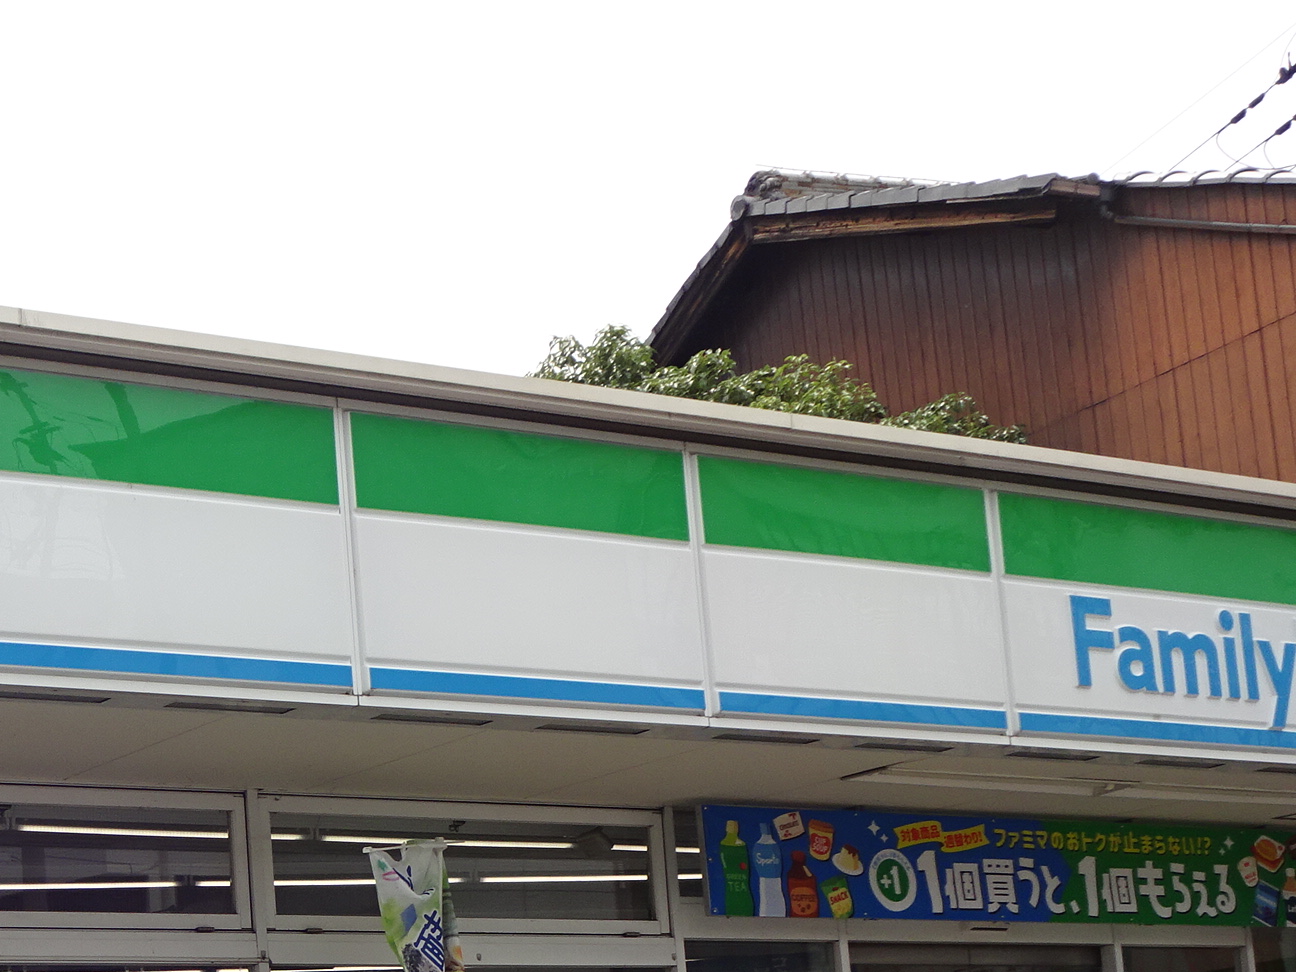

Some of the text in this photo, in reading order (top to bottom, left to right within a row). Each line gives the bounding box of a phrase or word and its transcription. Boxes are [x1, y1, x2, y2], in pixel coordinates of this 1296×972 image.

[1069, 594, 1296, 729] Family
[994, 828, 1212, 856] ファミマのおトクが止まらない!?
[728, 881, 746, 892] TEA
